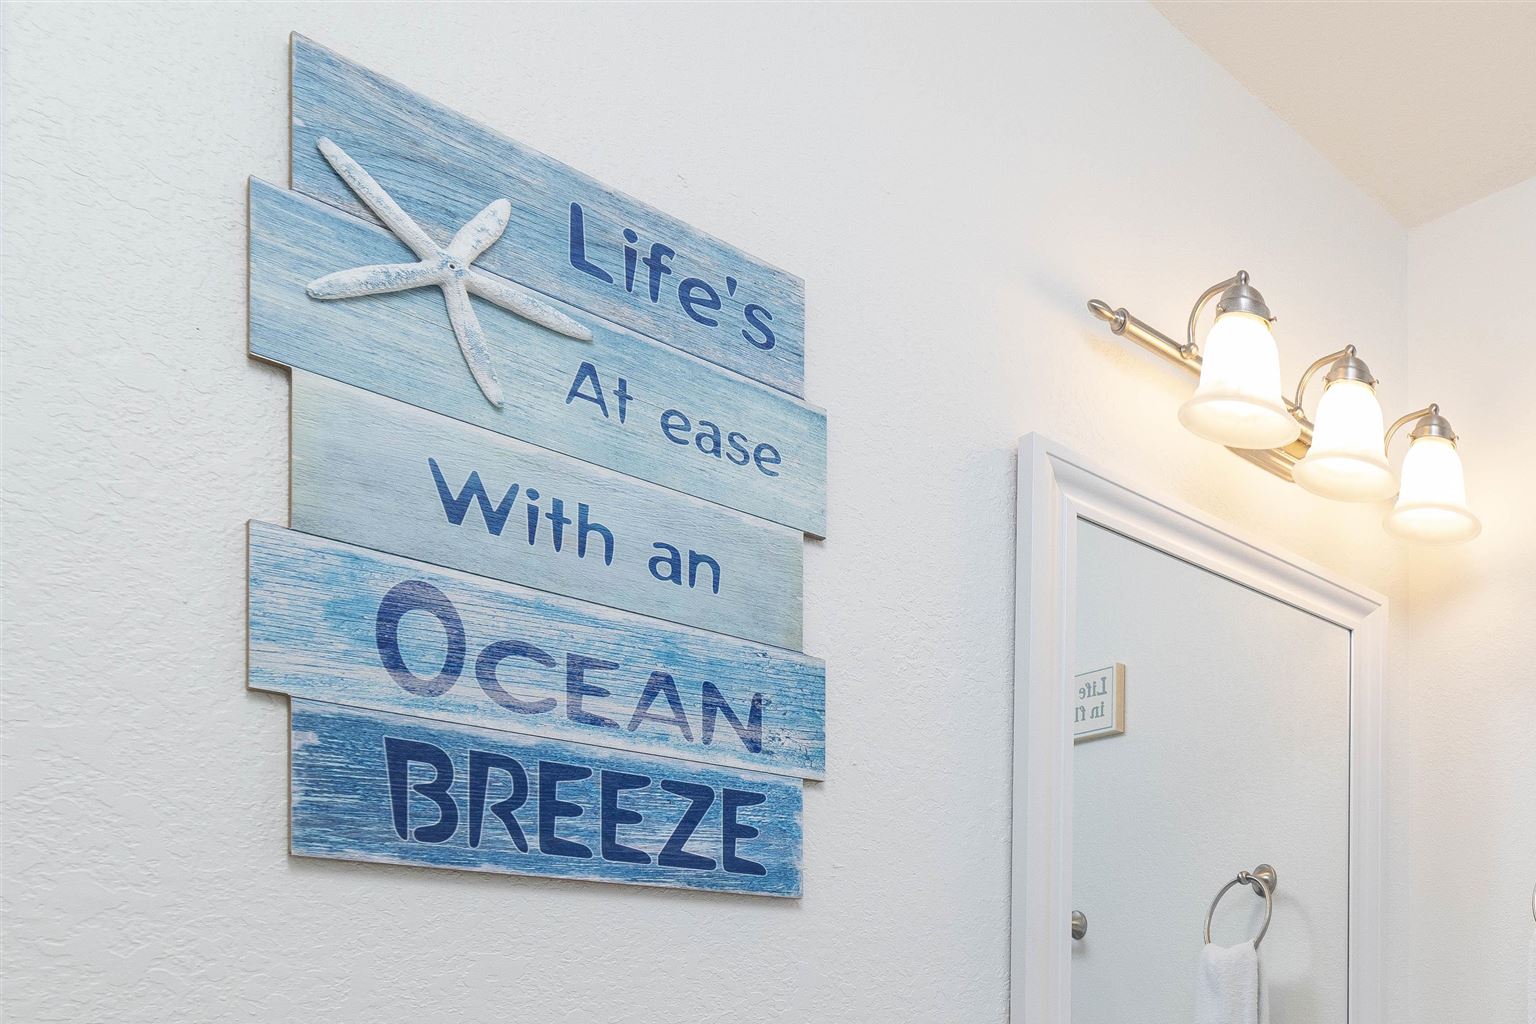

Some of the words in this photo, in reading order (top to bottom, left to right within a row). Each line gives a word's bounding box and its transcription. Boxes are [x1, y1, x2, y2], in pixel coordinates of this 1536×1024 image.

[569, 201, 777, 352] Life's
[566, 362, 634, 426] At
[660, 408, 782, 478] ease
[427, 457, 616, 567] With
[648, 540, 722, 596] an
[375, 579, 766, 754] OCEAN
[383, 735, 768, 877] BREEZE
